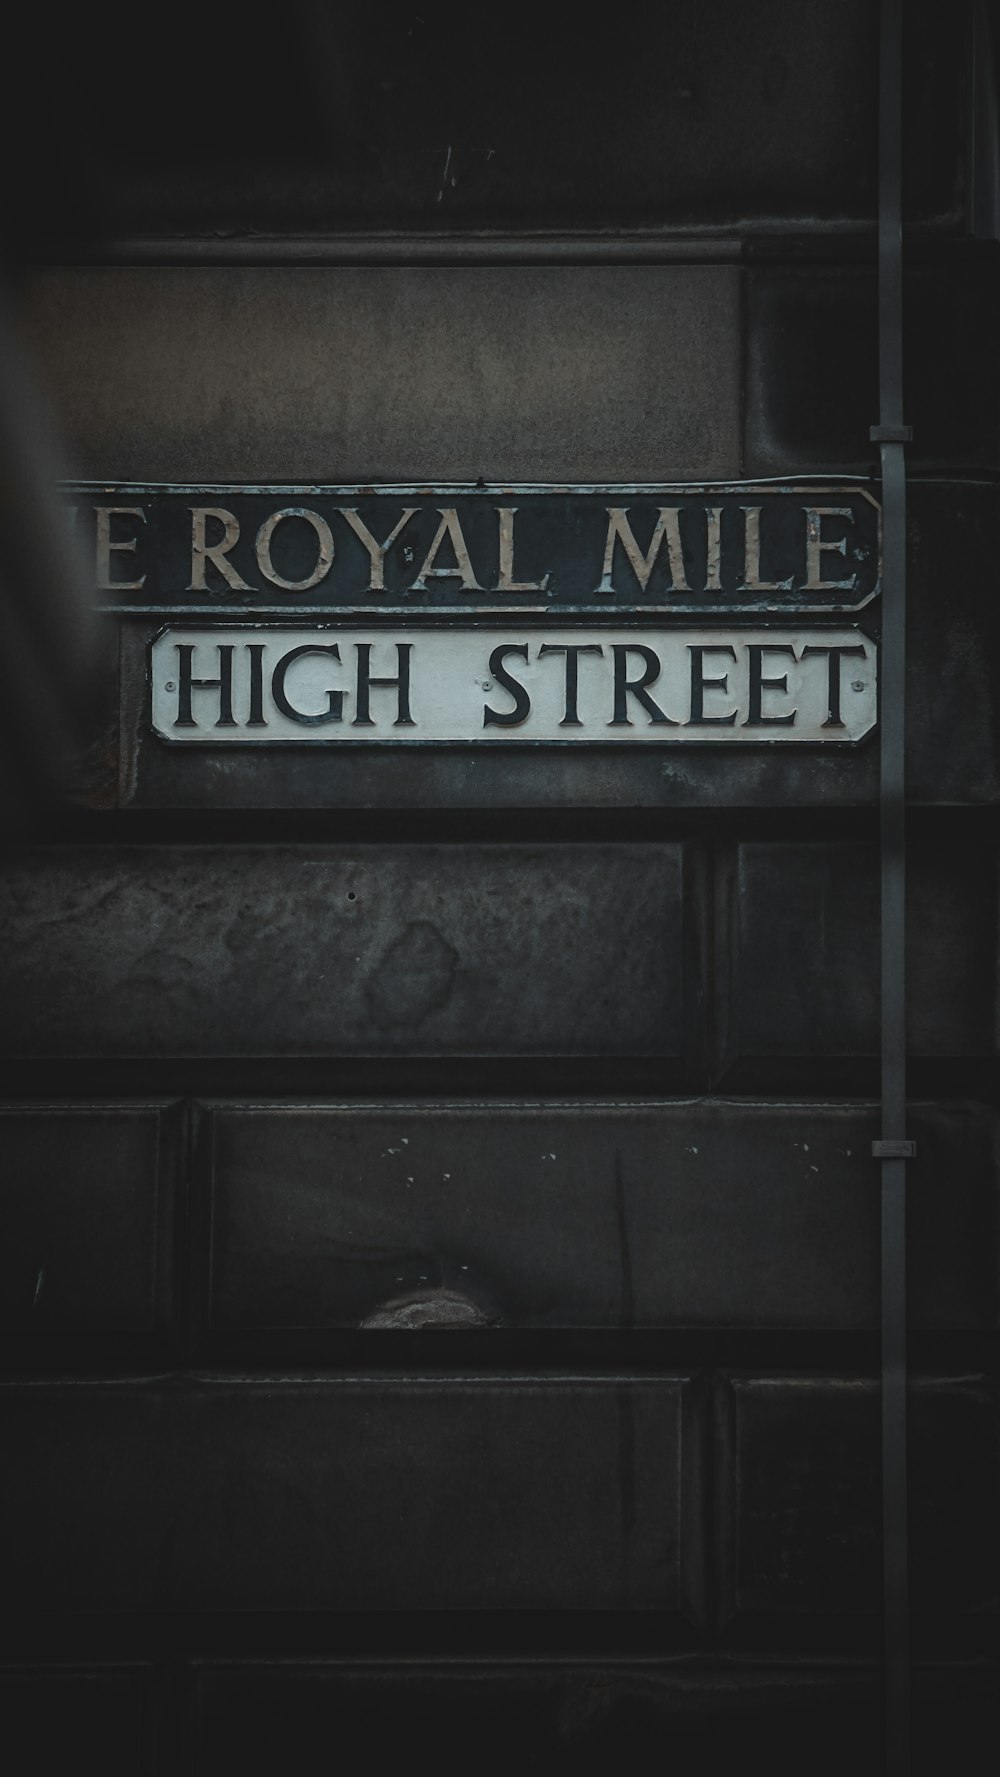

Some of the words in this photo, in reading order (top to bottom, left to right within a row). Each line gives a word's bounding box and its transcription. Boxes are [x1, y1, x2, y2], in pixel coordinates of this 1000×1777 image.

[66, 506, 148, 590] E
[185, 506, 551, 593] ROYAL
[595, 506, 856, 593] MILE
[175, 644, 418, 727] HIGH
[483, 643, 868, 727] STREET
